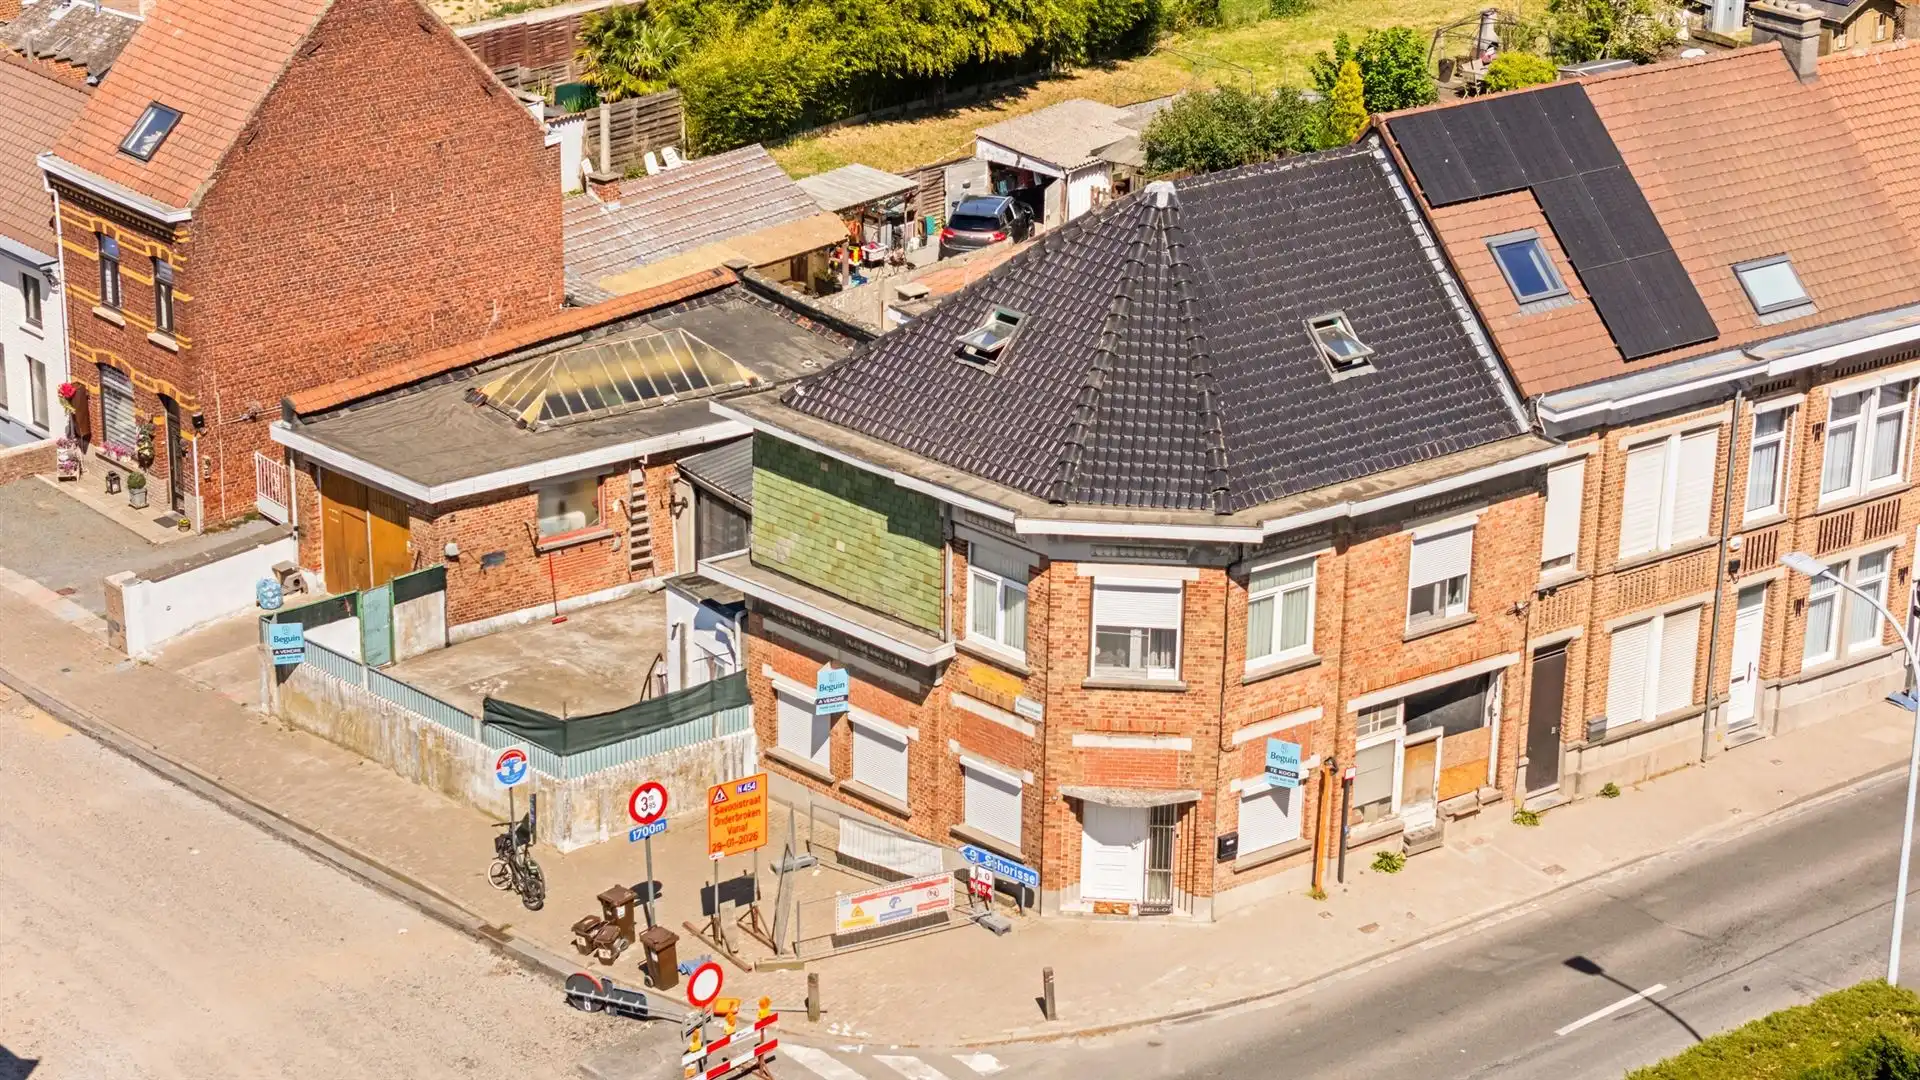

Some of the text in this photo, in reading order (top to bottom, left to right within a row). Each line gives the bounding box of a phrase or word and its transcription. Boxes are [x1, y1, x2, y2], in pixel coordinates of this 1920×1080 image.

[273, 635, 301, 645] Beguin
[819, 682, 845, 692] Beguin
[1270, 751, 1298, 765] Beguin
[641, 796, 648, 811] 3
[713, 809, 761, 827] Onderbroken
[632, 822, 665, 841] 1700m
[727, 821, 748, 836] Vanaf
